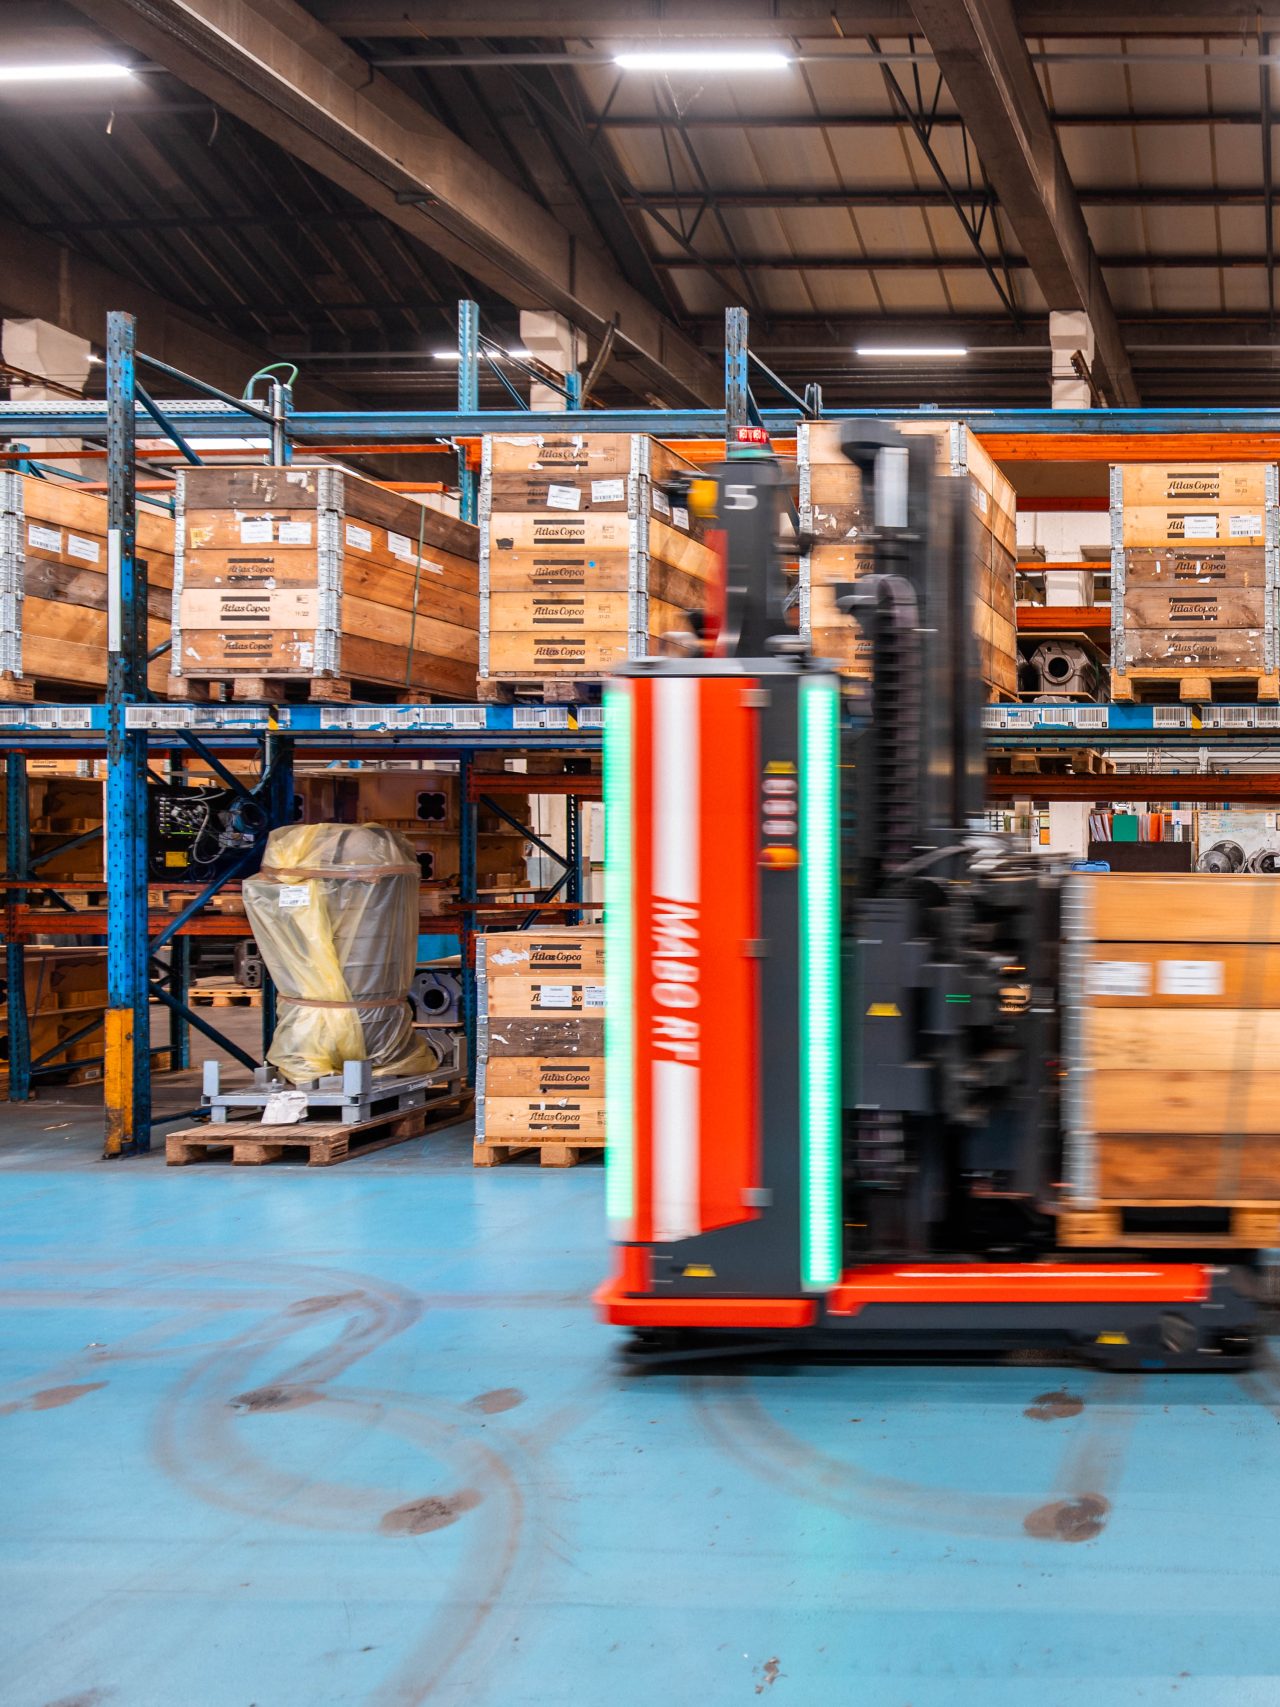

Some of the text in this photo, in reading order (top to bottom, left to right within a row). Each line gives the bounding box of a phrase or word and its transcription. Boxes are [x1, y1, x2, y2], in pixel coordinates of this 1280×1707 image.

[538, 448, 588, 460] Atlas Copco
[1168, 480, 1220, 492] Atlas Copco
[1167, 520, 1184, 530] Atl
[535, 526, 585, 538] Atlas Copco
[251, 564, 274, 576] Copco
[1201, 560, 1226, 572] Copco
[534, 567, 585, 578] Atlas Copco
[221, 603, 270, 614] Atlas Copco
[534, 606, 584, 618] Atlas Copco
[1169, 604, 1194, 613] Atlas
[225, 642, 273, 652] Atlas Copco
[536, 646, 585, 658] Atlas Copco
[1193, 642, 1217, 654] Copco
[532, 952, 581, 963] Atlas Copco
[540, 1073, 590, 1084] Atlas Copco
[529, 1112, 580, 1123] Atlas Copco
